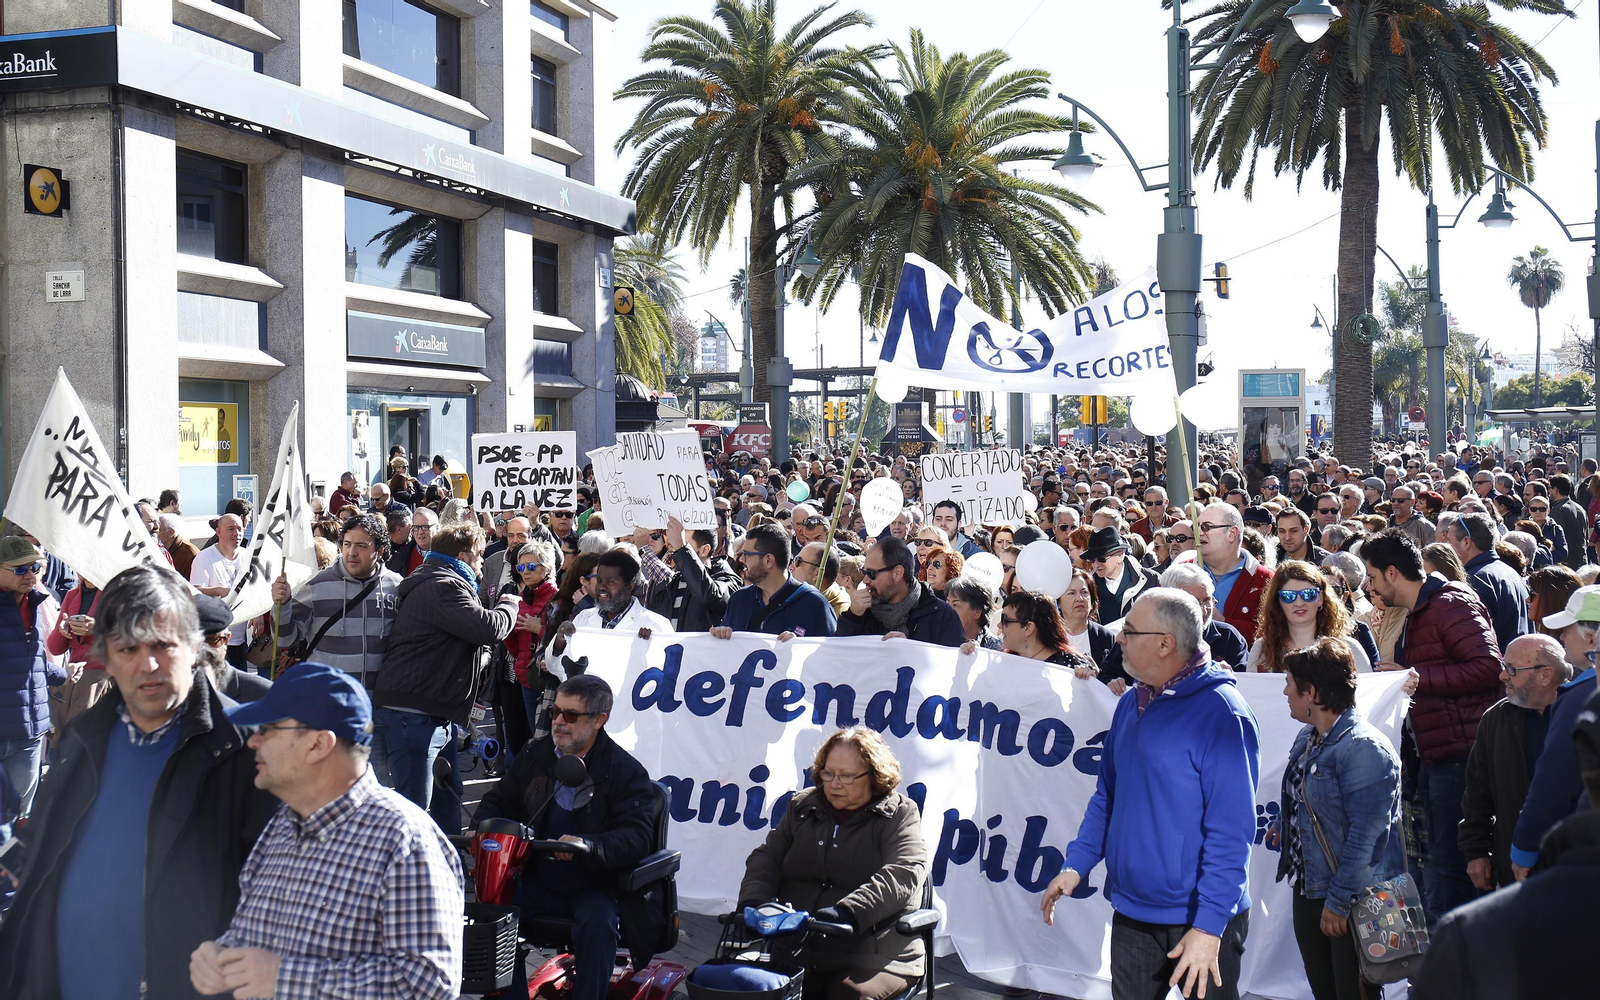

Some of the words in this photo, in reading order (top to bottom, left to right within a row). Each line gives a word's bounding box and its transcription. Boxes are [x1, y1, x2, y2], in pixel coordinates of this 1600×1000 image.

[438, 147, 476, 174] CaixaBank
[53, 290, 59, 298] DE
[1074, 306, 1099, 336] A
[410, 331, 449, 352] CaixaBank
[1053, 344, 1171, 379] RECORTE
[617, 433, 665, 461] SANIDAD
[677, 446, 700, 461] PARA
[732, 434, 771, 446] KFC
[478, 445, 522, 465] PSOE
[537, 444, 563, 463] PP
[922, 450, 1021, 482] CONCERTADO
[494, 467, 574, 487] RECORTAN
[657, 473, 708, 502] TODAS
[976, 480, 988, 492] a
[45, 450, 115, 539] PARA
[481, 490, 494, 510] A
[500, 489, 525, 510] LA
[533, 488, 573, 508] VEZ
[679, 506, 717, 526] 16/2012
[925, 495, 1024, 526] PATIZADO
[632, 643, 1108, 776] defendamos
